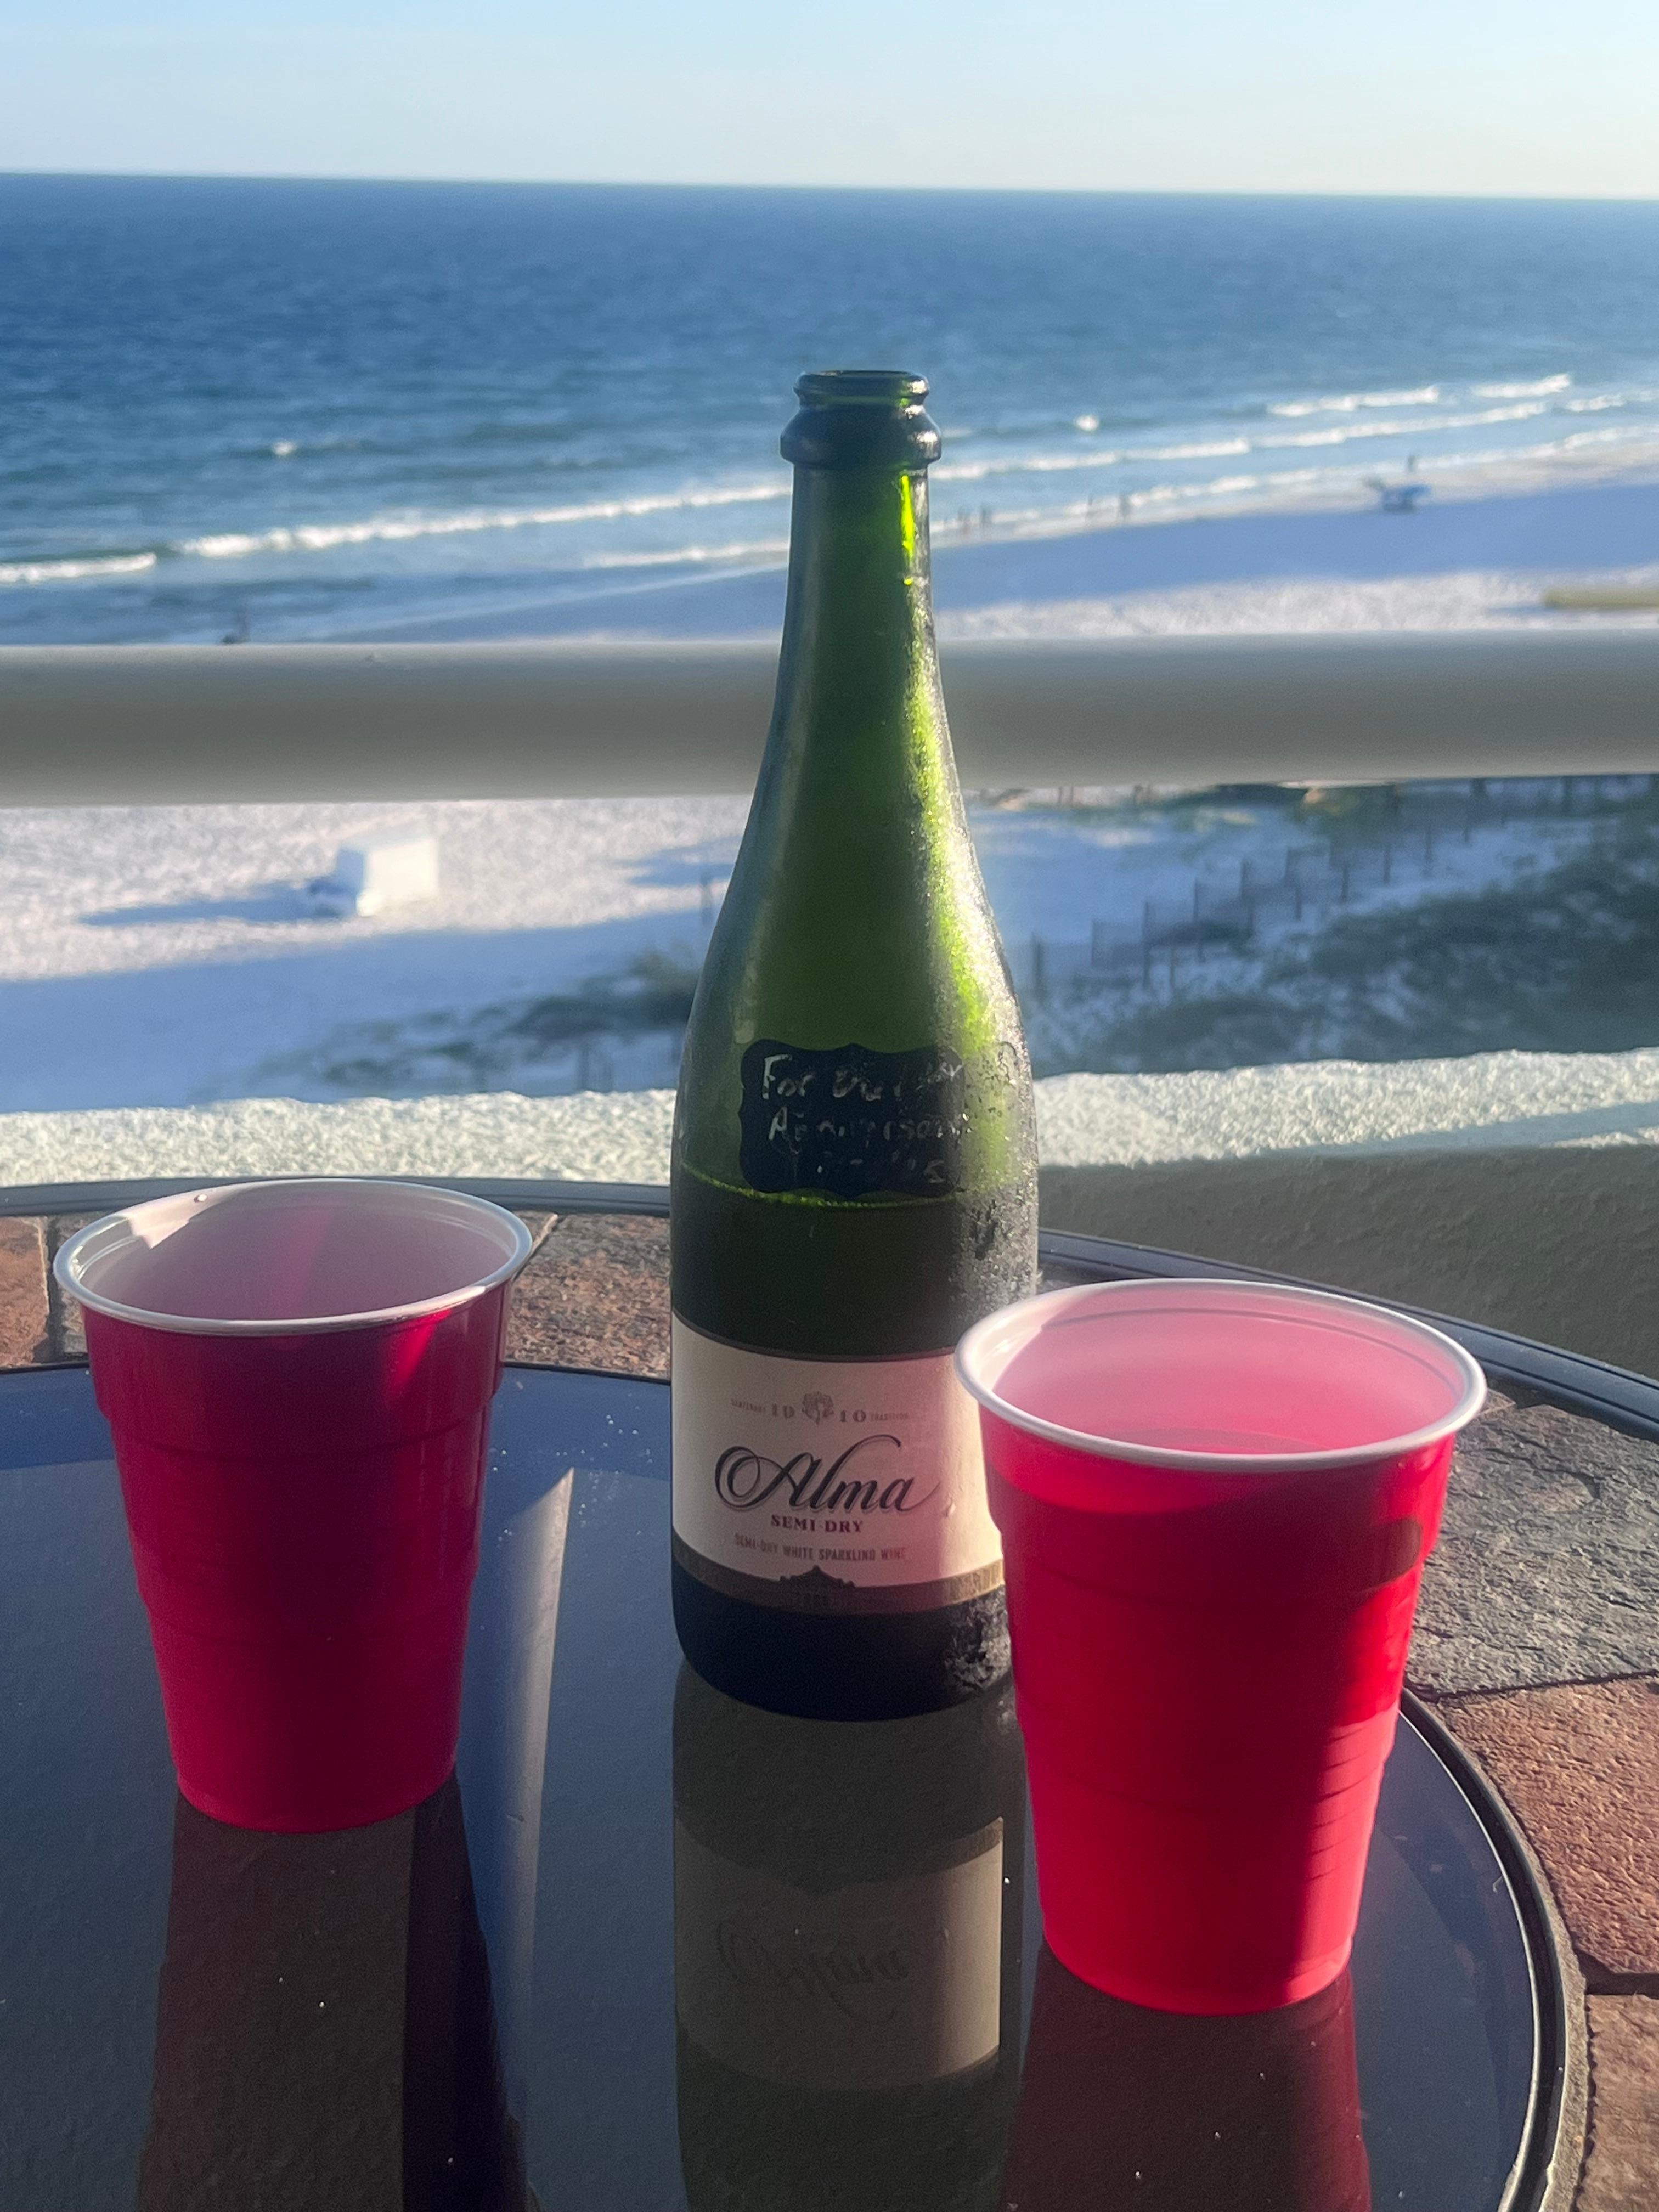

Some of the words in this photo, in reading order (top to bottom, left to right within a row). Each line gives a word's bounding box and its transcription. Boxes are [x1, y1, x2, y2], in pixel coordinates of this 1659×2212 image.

[761, 1053, 817, 1100] For
[714, 1434, 939, 1513] Alma
[782, 1544, 815, 1561] WHITE
[819, 1548, 876, 1561] SPARKLING
[881, 1547, 907, 1561] WINE
